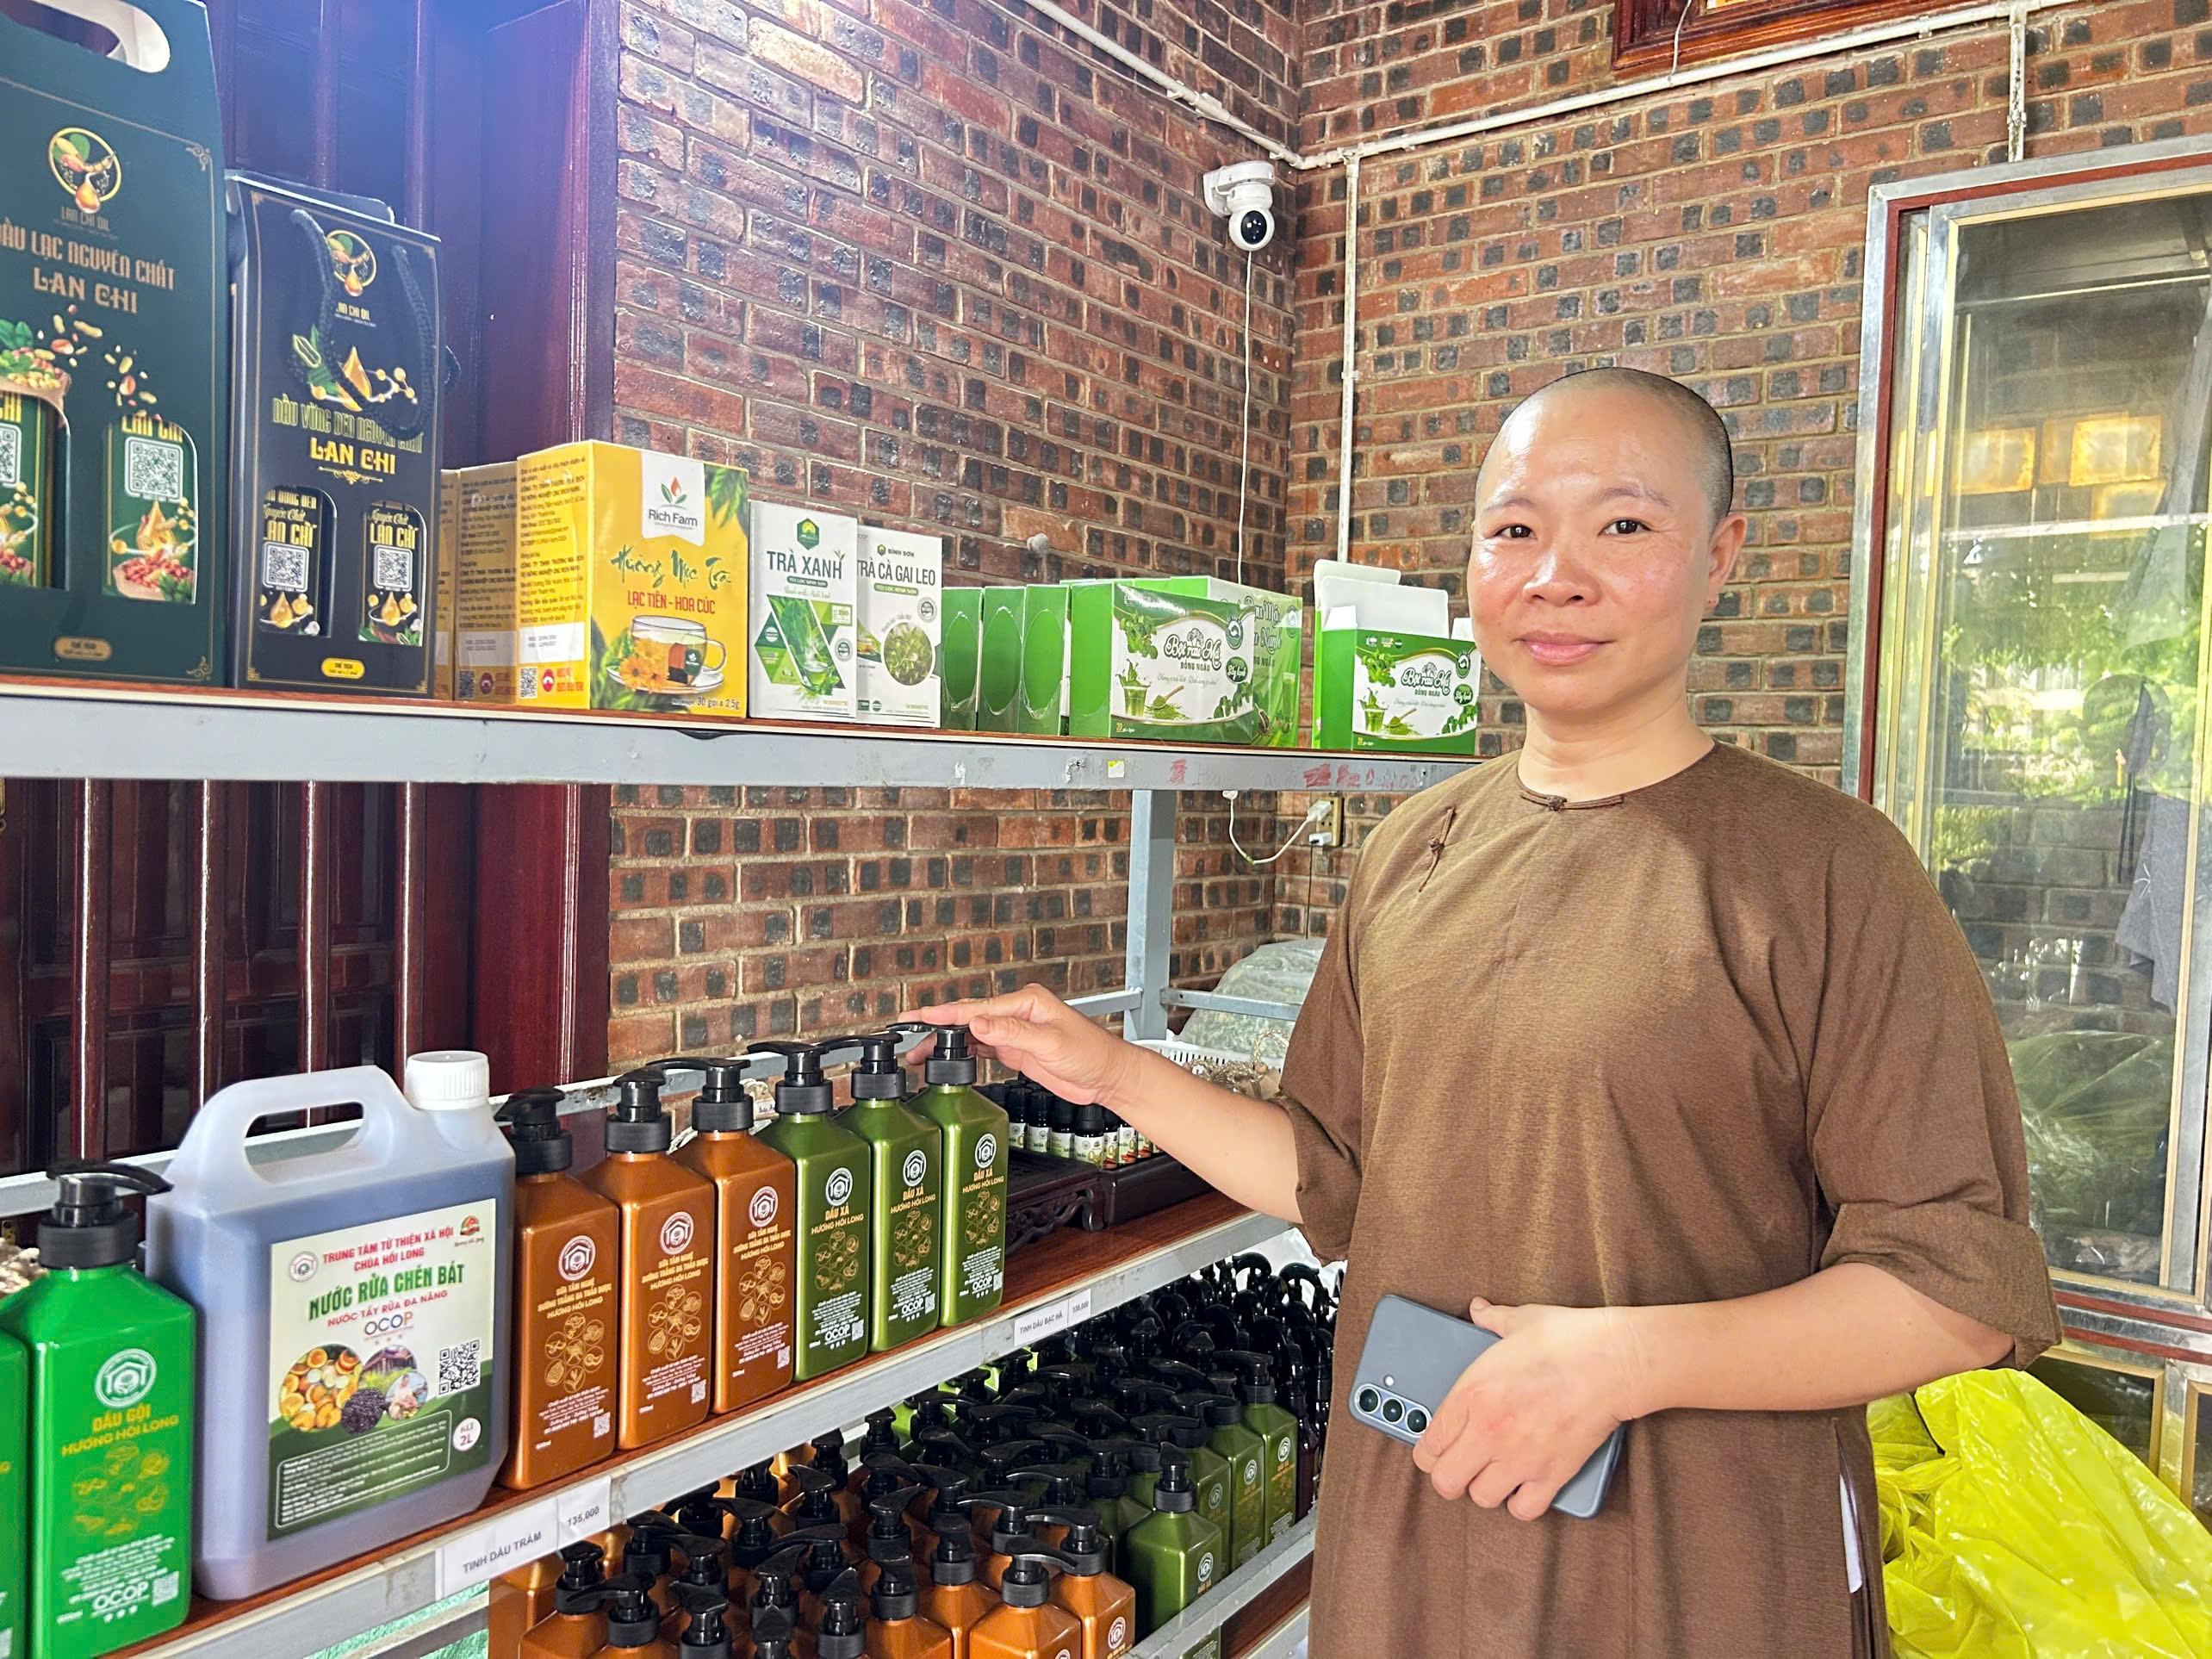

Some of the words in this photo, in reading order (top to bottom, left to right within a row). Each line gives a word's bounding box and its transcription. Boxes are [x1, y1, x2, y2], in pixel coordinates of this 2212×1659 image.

[31, 230, 63, 261] LẠC
[68, 241, 130, 278] NGUYÊN
[136, 258, 176, 290] CHẤT
[34, 266, 85, 301] LAN
[95, 283, 138, 314] CHI
[272, 393, 298, 426] DẦU
[310, 438, 354, 466] LAN
[360, 449, 396, 475] CHI
[649, 507, 671, 525] Rich
[673, 513, 699, 528] Farm
[767, 548, 797, 574] TRÀ
[802, 556, 842, 580] XANH
[857, 557, 876, 578] TRÀ
[878, 560, 892, 581] CÀ
[895, 565, 912, 582] GAI
[916, 568, 936, 586] LEO
[627, 590, 645, 610] LẠC
[675, 597, 697, 612] HOA
[697, 596, 717, 614] CÚC
[1163, 633, 1188, 661] Bột
[1186, 645, 1202, 660] rau
[1200, 637, 1222, 671] Má
[962, 1183, 982, 1194] HƯƠNG
[991, 1175, 1004, 1186] LONG
[973, 1171, 985, 1182] DẦU
[985, 1166, 993, 1178] XẢ
[890, 1202, 910, 1214] HƯƠNG
[921, 1193, 936, 1205] LONG
[903, 1189, 915, 1201] DẦU
[916, 1184, 924, 1196] XẢ
[825, 1207, 839, 1221] DẦU
[841, 1202, 850, 1216] XẢ
[811, 1222, 834, 1235] HƯƠNG
[846, 1213, 865, 1227] LONG
[323, 1248, 355, 1264] TRUNG
[357, 1242, 378, 1256] TÂM
[382, 1237, 394, 1251] TỪ
[395, 1233, 422, 1251] THIỆN
[439, 1227, 454, 1240] HỘI
[740, 1249, 761, 1261] HƯƠNG
[769, 1241, 785, 1253] LONG
[354, 1254, 380, 1272] CHÙA
[401, 1247, 425, 1261] LONG
[309, 1285, 352, 1322] NƯỚC
[357, 1272, 388, 1305] RỬA
[394, 1264, 432, 1294] CHÉN
[438, 1260, 465, 1286] BÁT
[649, 1277, 674, 1290] HƯƠNG
[684, 1269, 701, 1282] LONG
[972, 1275, 993, 1291] OCOP
[327, 1312, 358, 1327] NƯỚC
[360, 1305, 378, 1319] TẨY
[382, 1300, 401, 1314] RỬA
[404, 1296, 417, 1308] ĐA
[420, 1289, 448, 1304] NĂNG
[546, 1307, 571, 1320] HƯƠNG
[583, 1296, 604, 1309] LONG
[901, 1297, 924, 1315] OCOP
[364, 1311, 414, 1336] OCOP
[825, 1323, 851, 1341] OCOP
[1020, 1325, 1032, 1335] TINH
[1032, 1319, 1044, 1330] DẦU
[1044, 1314, 1055, 1325] BẠC
[92, 1411, 122, 1433] DẦU
[61, 1431, 113, 1457] HƯƠNG
[143, 1414, 180, 1434] LONG
[460, 1434, 472, 1445] 2L
[567, 1506, 600, 1527] 135,000
[463, 1556, 488, 1574] TINH
[489, 1544, 511, 1563] DẦU
[513, 1531, 542, 1554] TRÀM
[93, 1581, 149, 1611] OCOP
